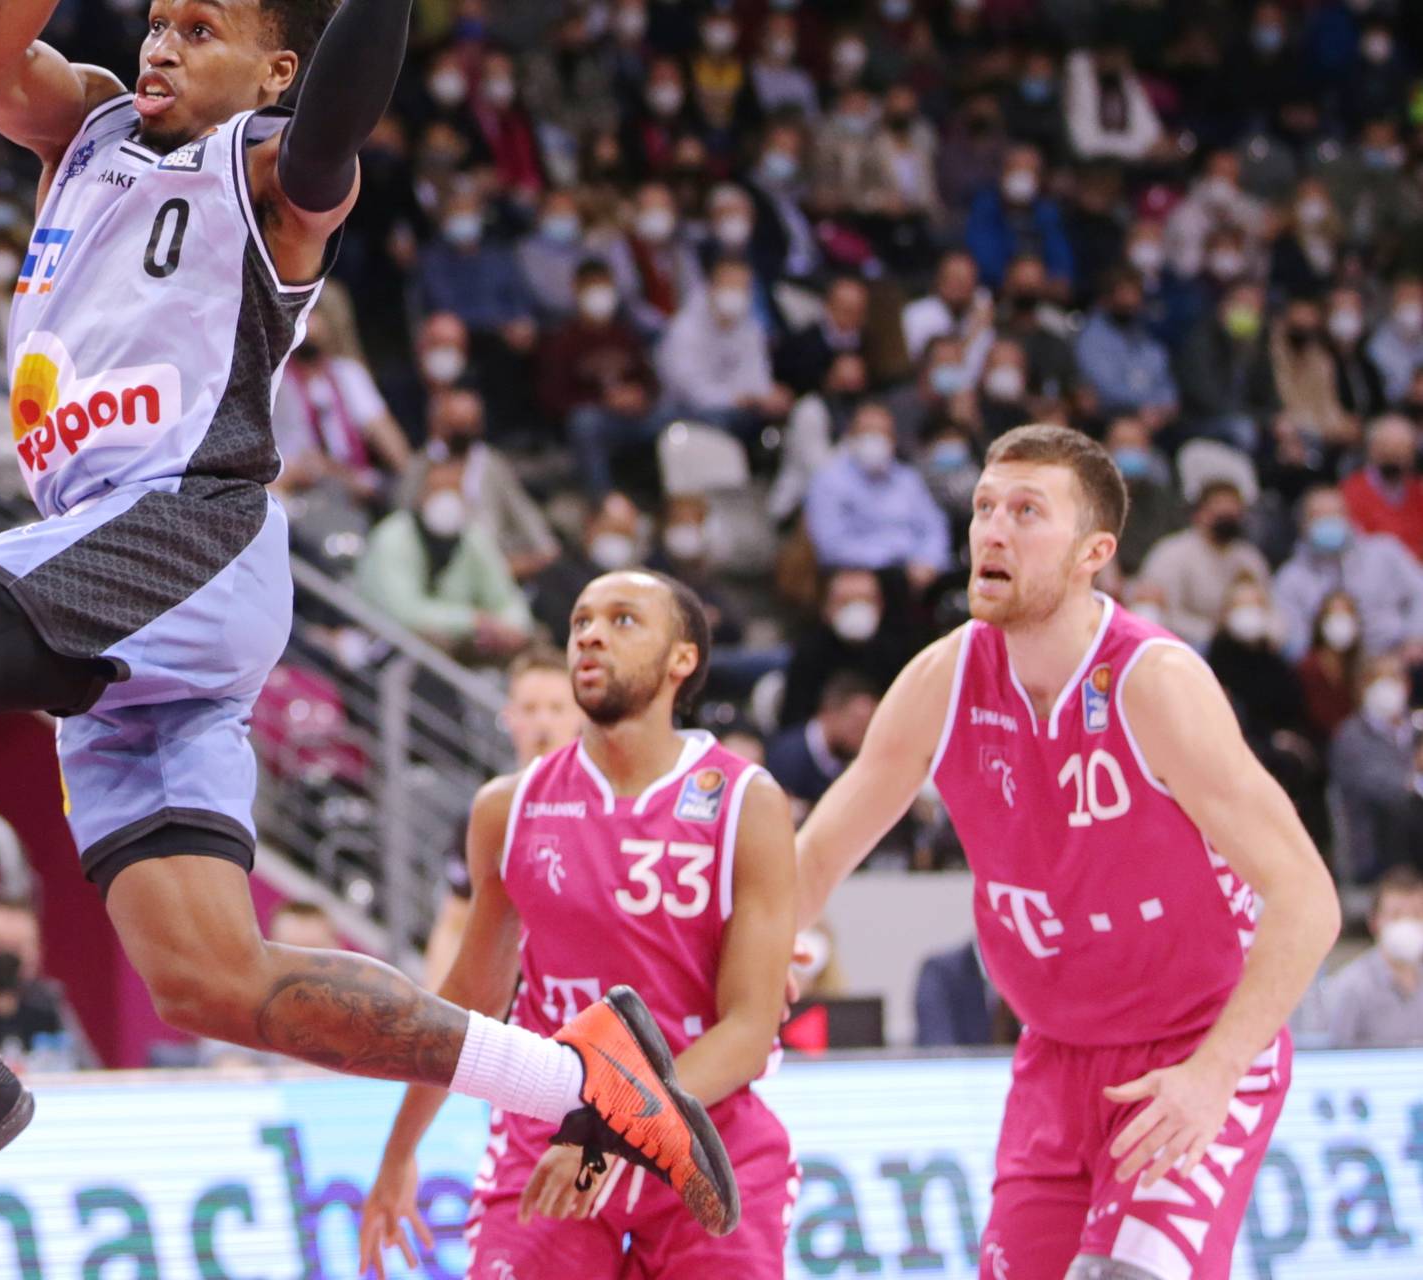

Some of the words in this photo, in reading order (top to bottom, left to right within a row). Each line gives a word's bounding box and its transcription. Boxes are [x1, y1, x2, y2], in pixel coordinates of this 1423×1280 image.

[143, 197, 191, 279] 0
[1056, 748, 1132, 828] 10
[614, 837, 716, 920] 33
